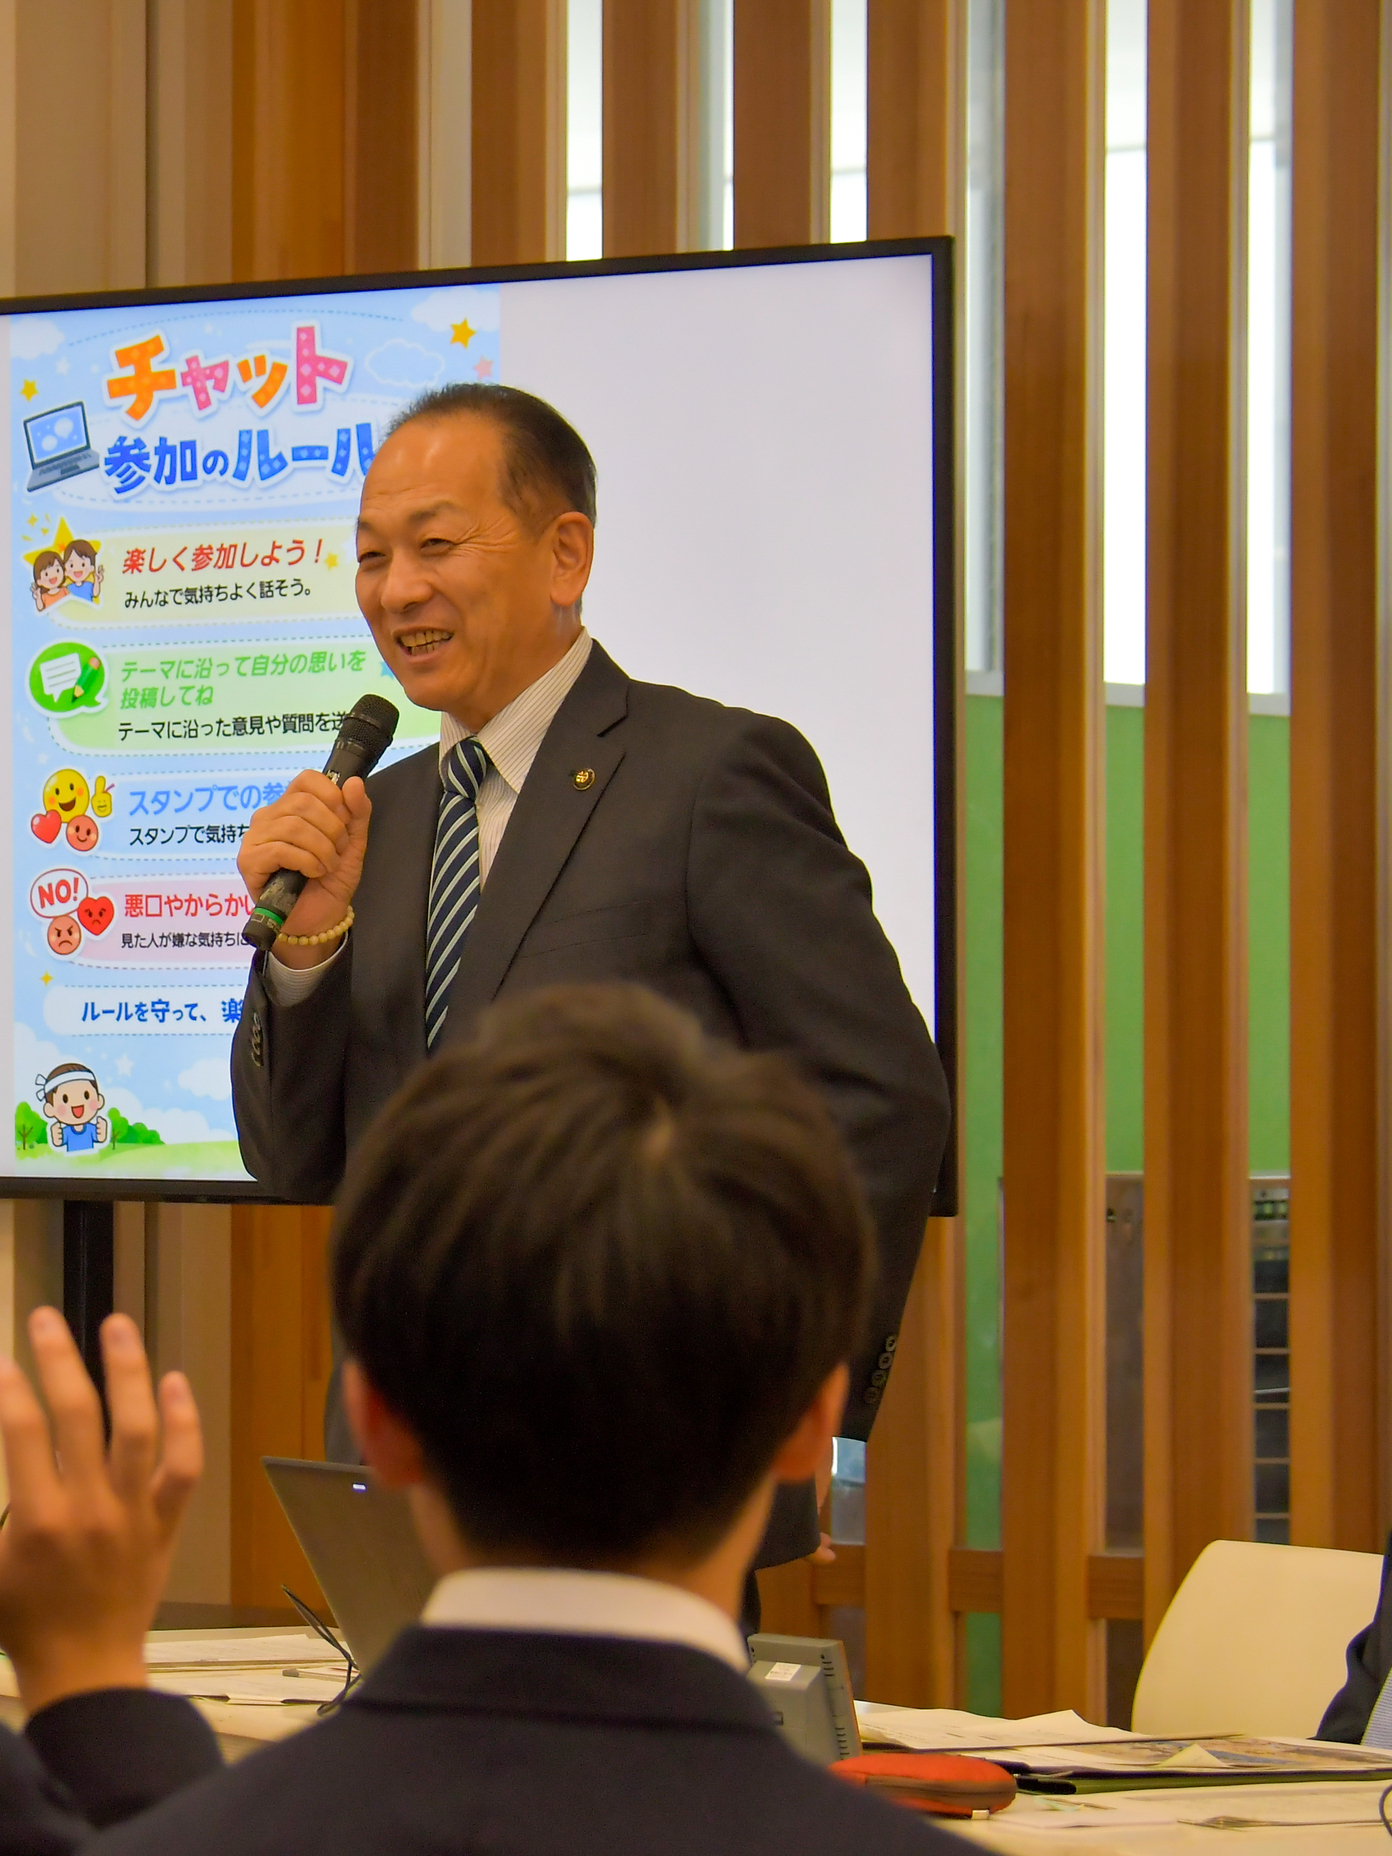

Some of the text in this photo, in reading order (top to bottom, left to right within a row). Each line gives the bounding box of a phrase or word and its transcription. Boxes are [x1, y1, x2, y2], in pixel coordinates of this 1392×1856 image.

[107, 325, 348, 421] チャット
[104, 422, 377, 494] 参加のルール
[122, 539, 324, 575] 楽しく参加しよう！
[124, 578, 312, 610] みんなで気持ちよく話そう。
[120, 649, 366, 682] テーマに沿って自分の思いを
[120, 684, 213, 710] 投稿してね
[129, 781, 291, 817] スタンプでの参
[37, 877, 80, 908] NO!
